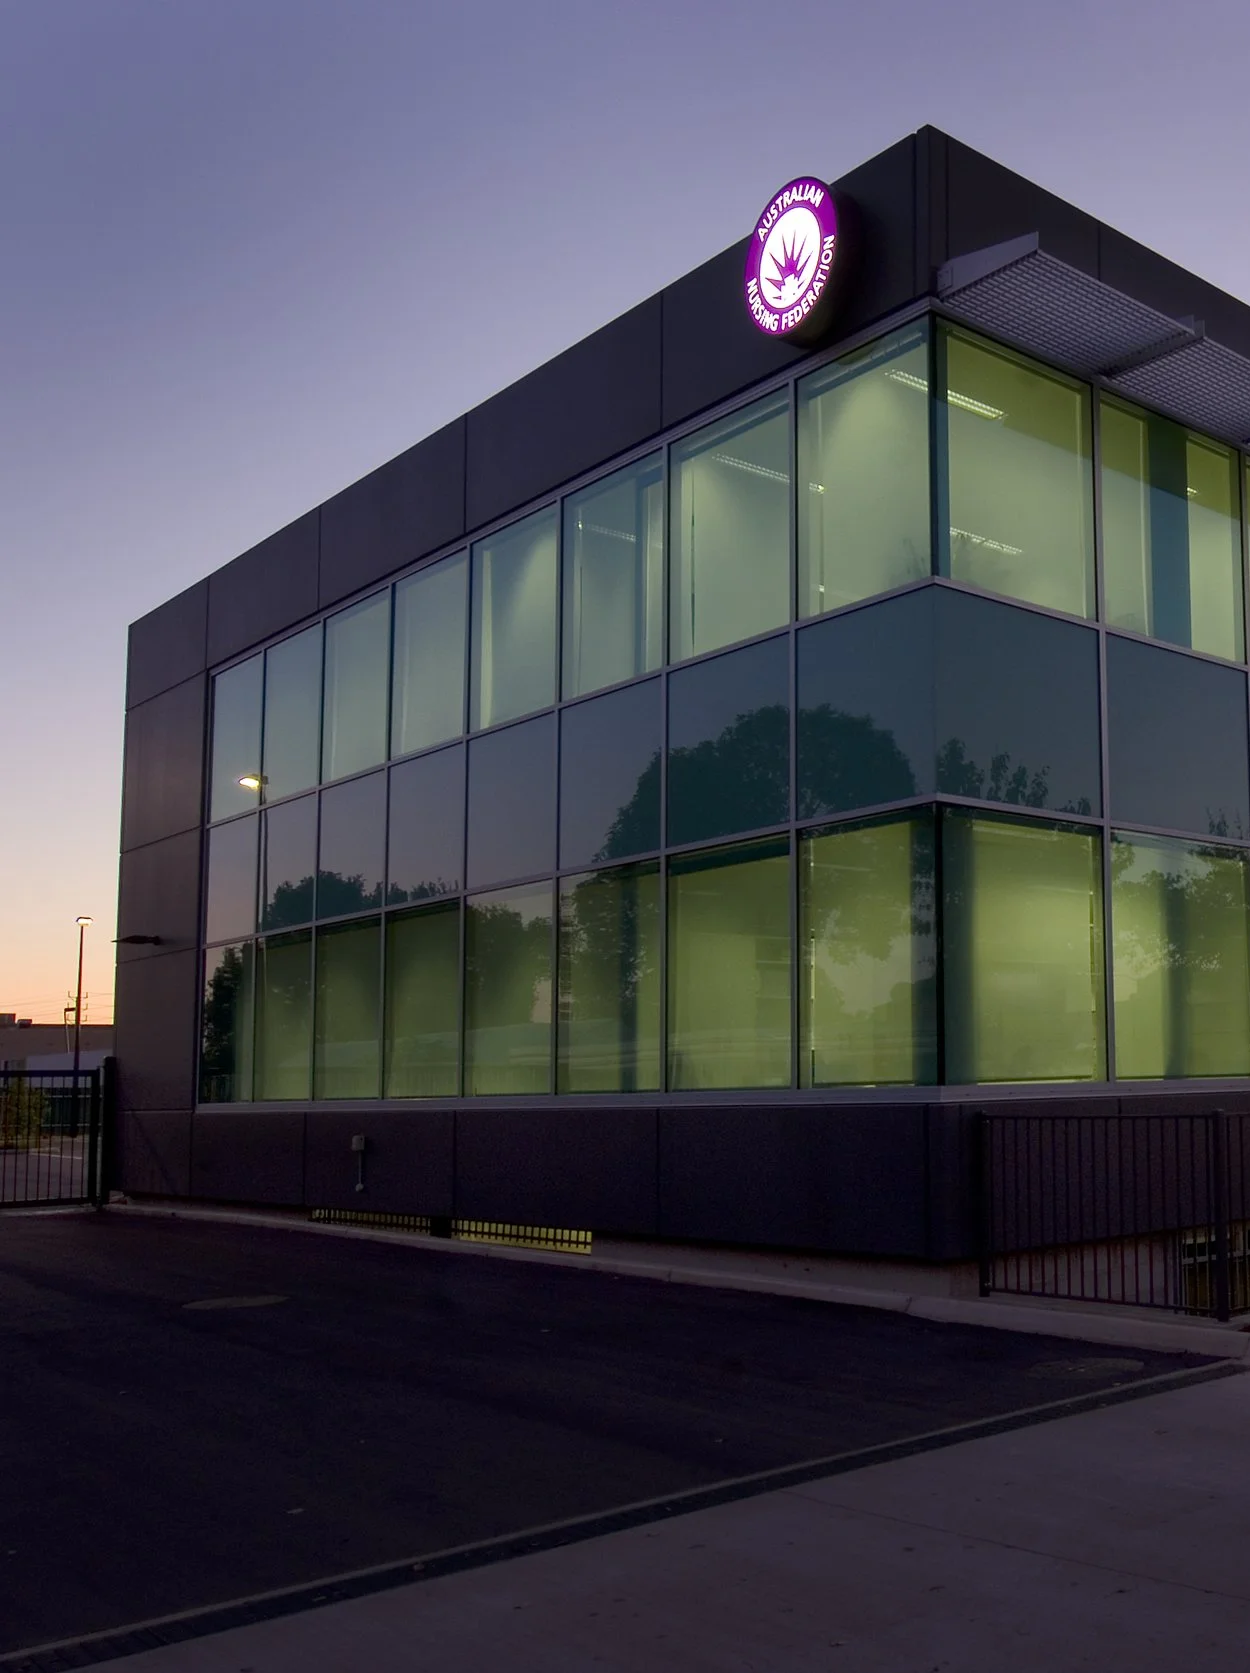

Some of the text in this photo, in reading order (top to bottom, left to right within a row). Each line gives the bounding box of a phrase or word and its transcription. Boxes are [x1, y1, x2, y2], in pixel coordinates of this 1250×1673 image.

[757, 183, 824, 242] AUSTRALIAN
[747, 234, 835, 332] NURSING FEDERATION
